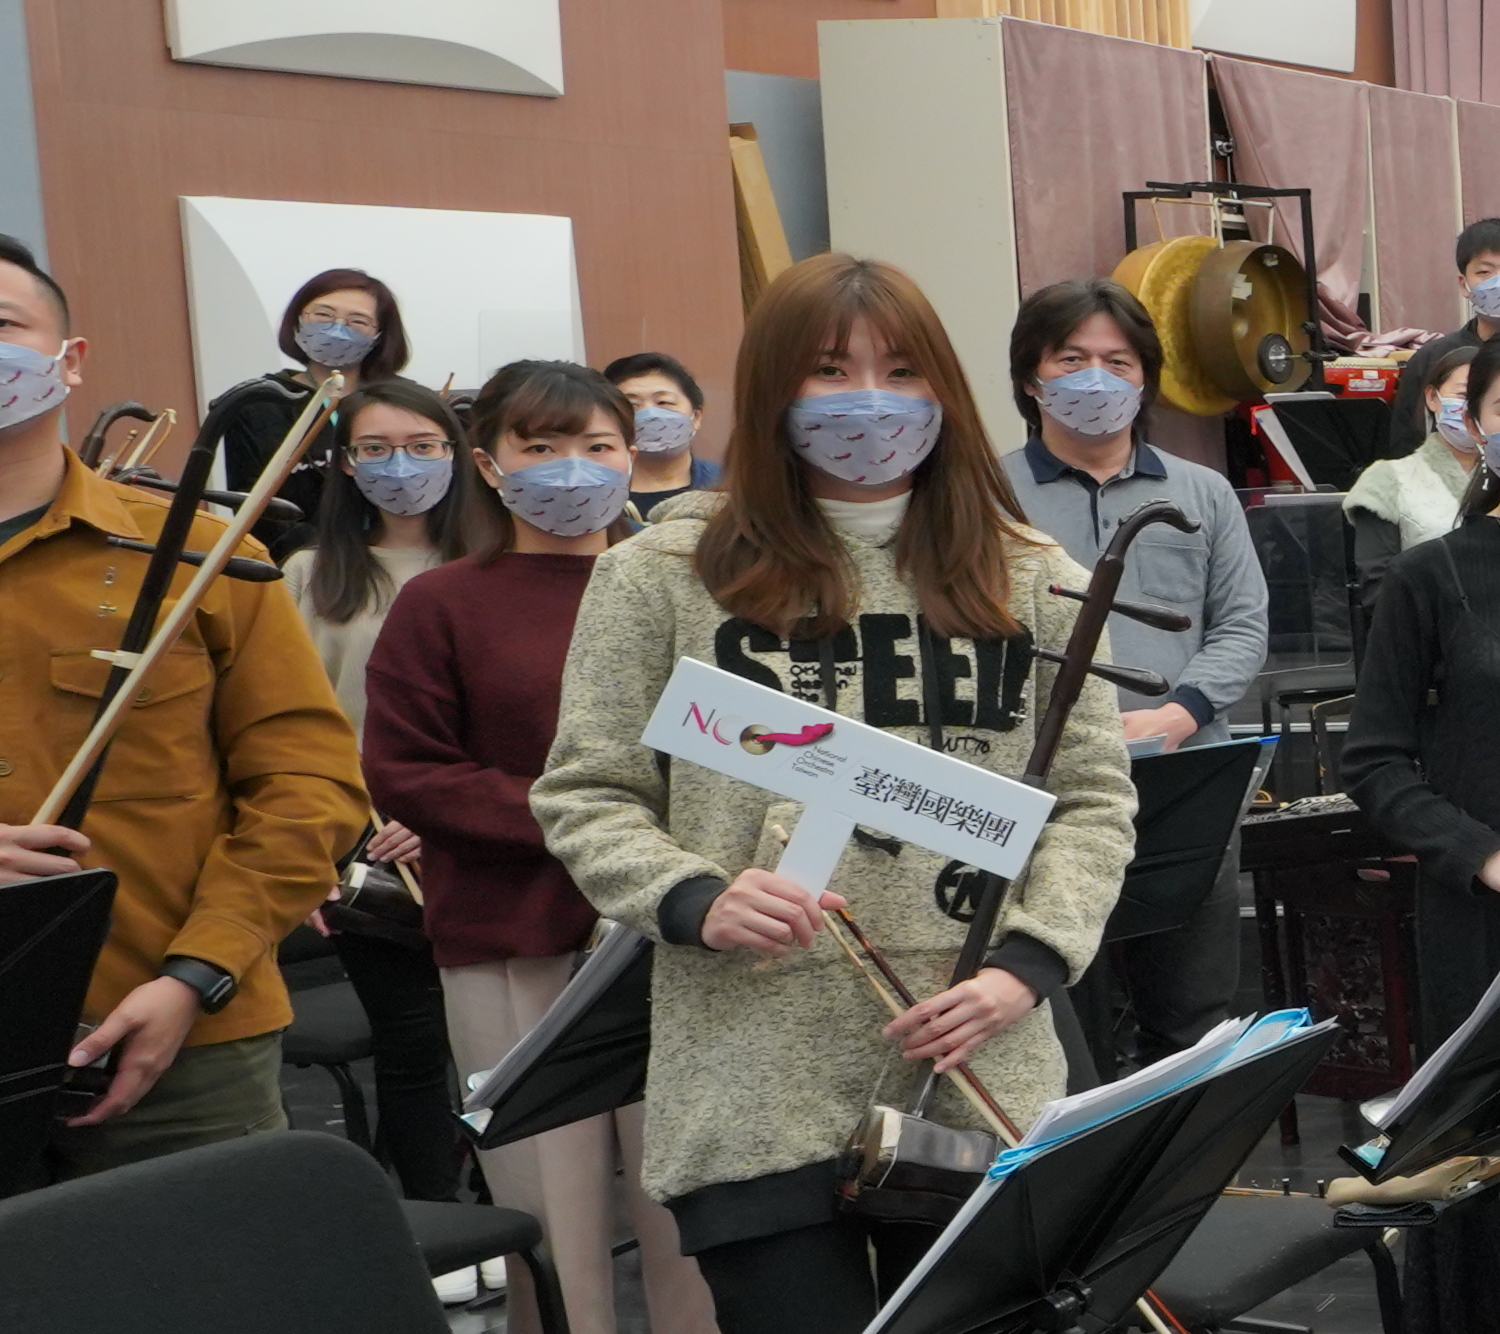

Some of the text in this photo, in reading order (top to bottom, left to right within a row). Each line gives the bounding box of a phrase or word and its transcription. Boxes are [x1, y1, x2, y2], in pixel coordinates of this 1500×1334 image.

[804, 750, 835, 767] Chinese
[813, 745, 848, 763] National
[847, 765, 1017, 848] 臺灣國樂團
